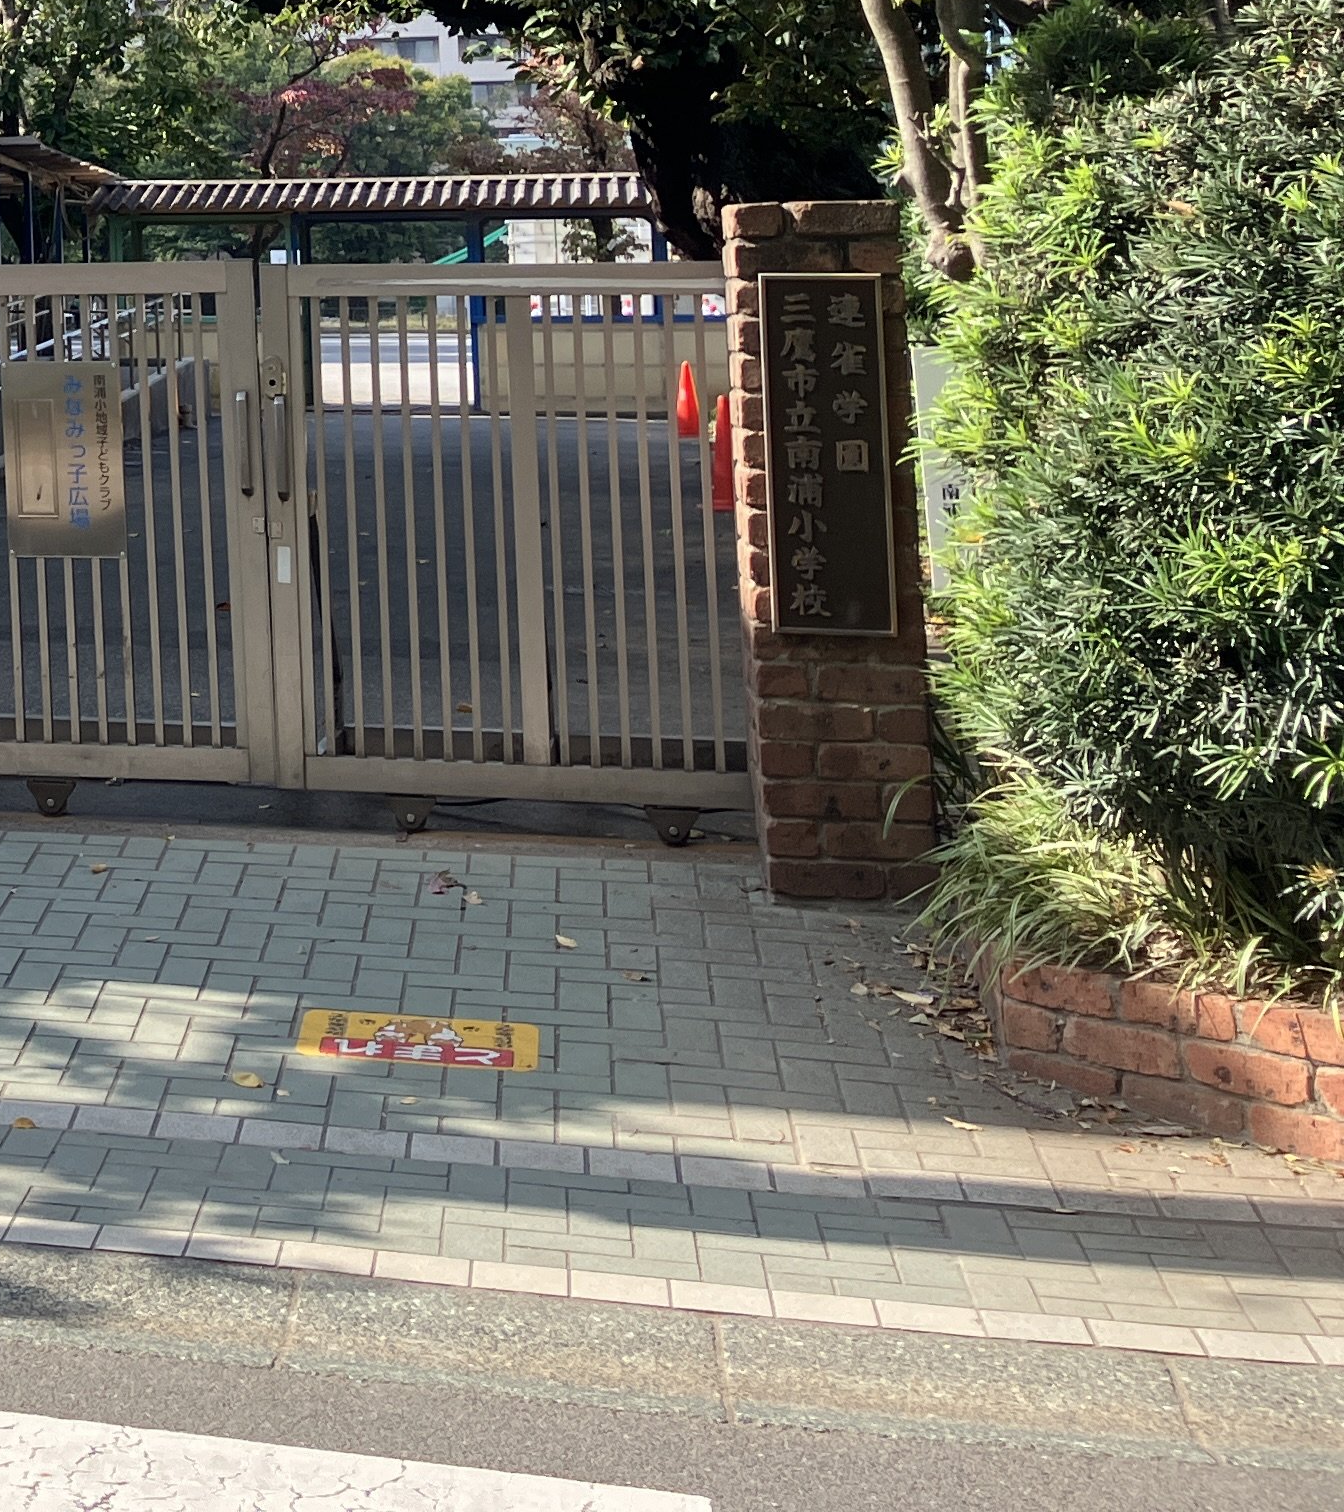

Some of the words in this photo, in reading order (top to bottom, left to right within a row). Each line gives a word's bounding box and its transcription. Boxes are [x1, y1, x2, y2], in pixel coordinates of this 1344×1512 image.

[64, 375, 91, 530] みなみっ子広場
[92, 374, 112, 510] 南浦小地域子どもクラブ
[779, 292, 832, 618] 三鷹市立南浦小学校
[827, 292, 870, 472] 連雀学園
[334, 1037, 502, 1066] とまれ
